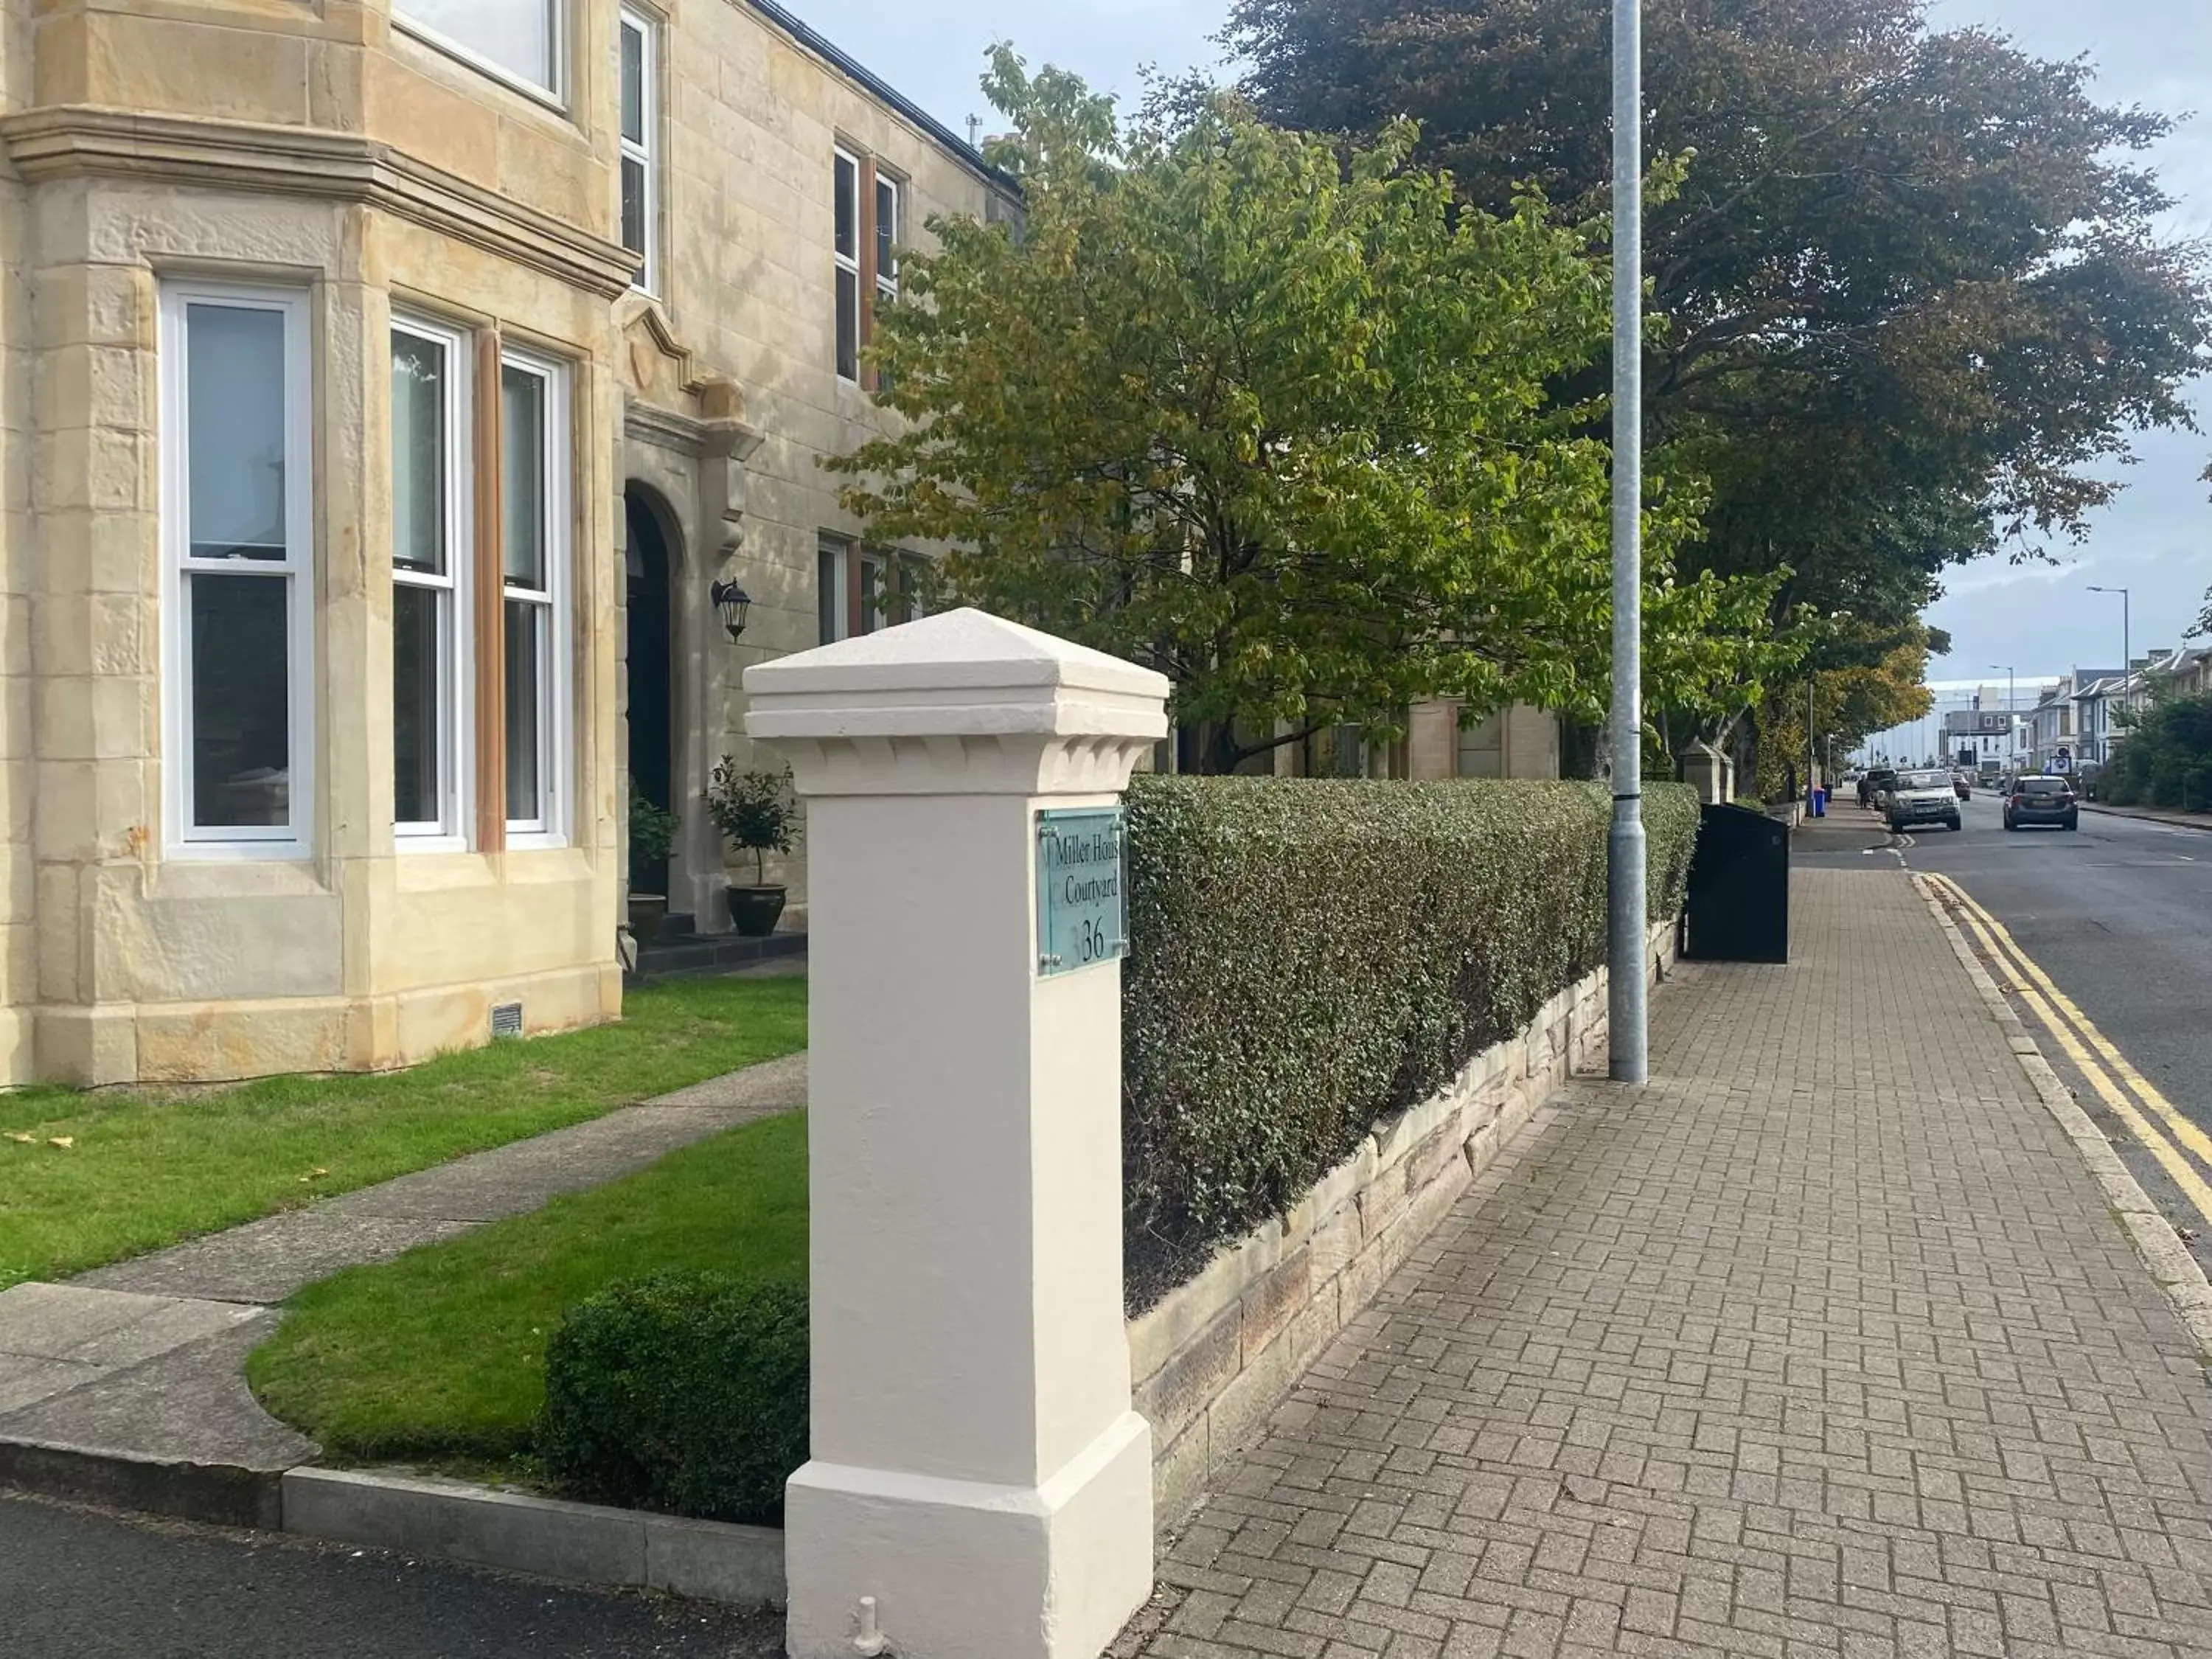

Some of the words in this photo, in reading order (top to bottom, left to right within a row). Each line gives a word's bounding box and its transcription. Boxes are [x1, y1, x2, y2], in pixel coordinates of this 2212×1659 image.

[1055, 834, 1091, 865] Miller
[1093, 834, 1123, 862] Hous
[1065, 869, 1118, 908] Courtyard
[1083, 916, 1105, 961] 36
